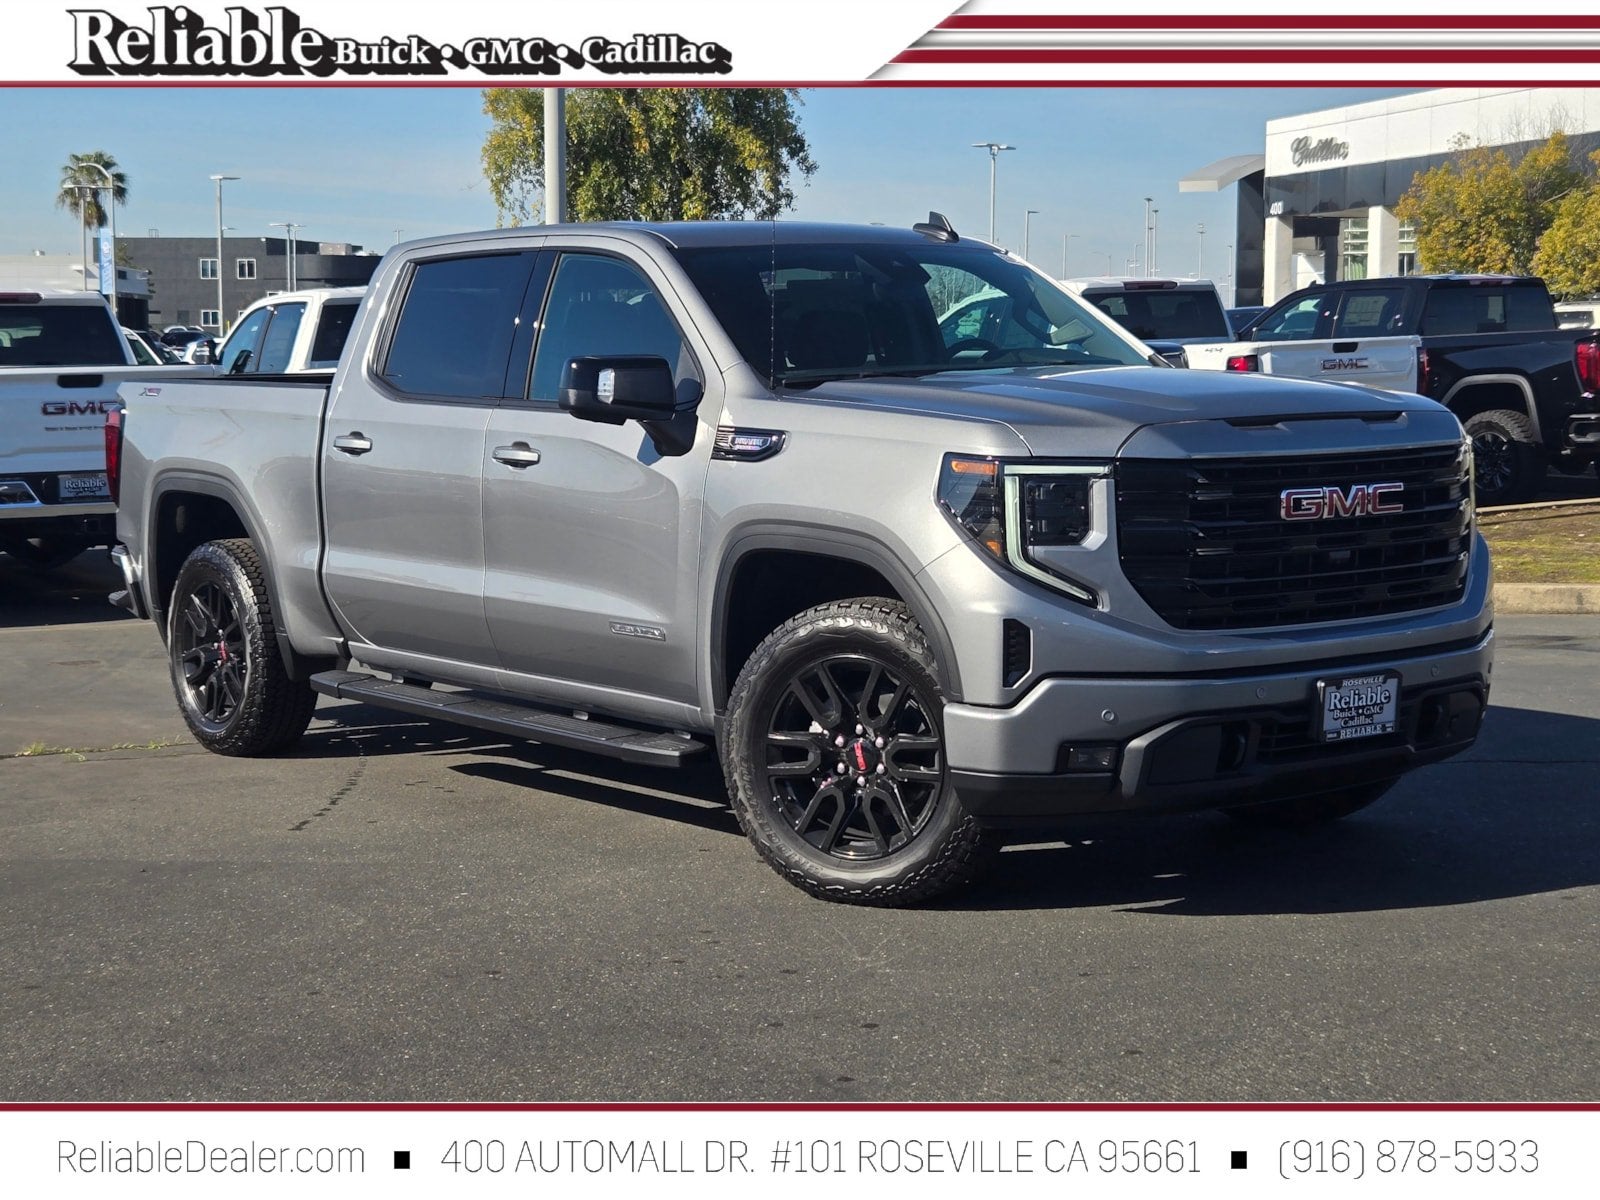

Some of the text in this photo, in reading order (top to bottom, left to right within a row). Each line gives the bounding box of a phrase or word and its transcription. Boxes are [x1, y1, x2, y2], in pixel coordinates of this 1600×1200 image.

[1290, 136, 1349, 168] Cadillac
[1269, 201, 1284, 216] 400
[1321, 358, 1368, 370] GMC
[42, 400, 118, 416] GMC
[65, 478, 105, 488] Reliable
[1280, 482, 1404, 520] GMC
[1343, 676, 1384, 686] ROSEVILLE
[1329, 686, 1390, 710] Reliable
[1334, 705, 1383, 718] Buick GMC
[1341, 715, 1373, 727] Cadillac
[1340, 725, 1382, 739] RELIABLE
